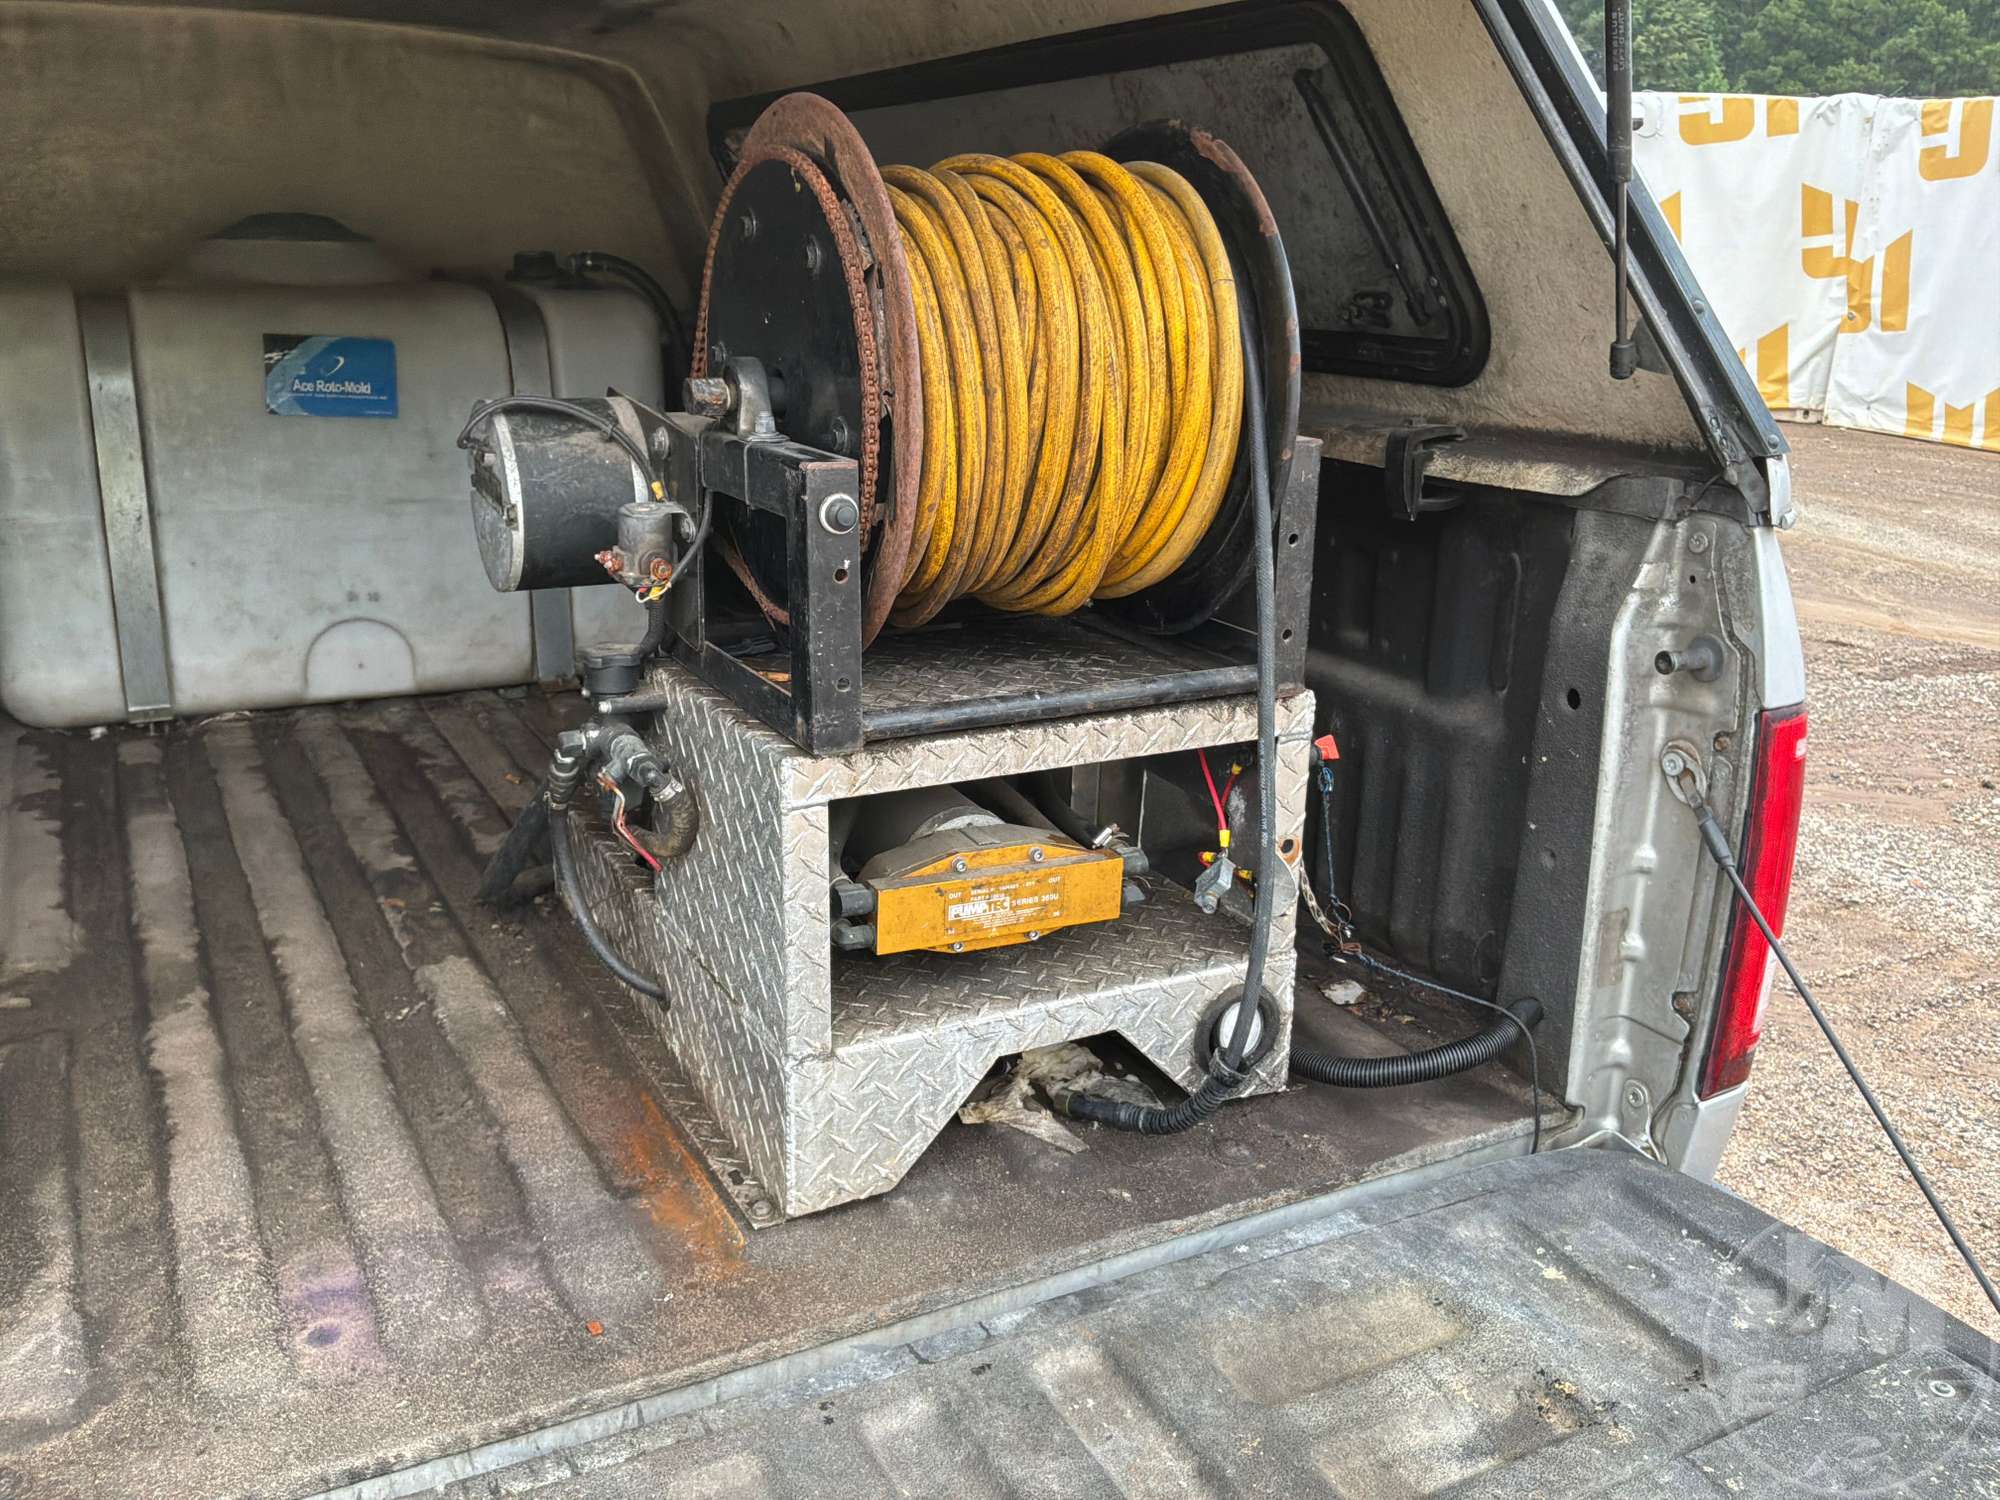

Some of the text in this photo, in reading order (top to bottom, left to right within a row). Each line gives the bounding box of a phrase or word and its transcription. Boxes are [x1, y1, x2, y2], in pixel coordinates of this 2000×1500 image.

[293, 379, 371, 394] Ace Roto-Mold
[1048, 876, 1061, 884] OUT
[948, 891, 962, 900] OUT
[1012, 896, 1038, 906] SERIES
[949, 898, 1010, 920] PUMPTEC
